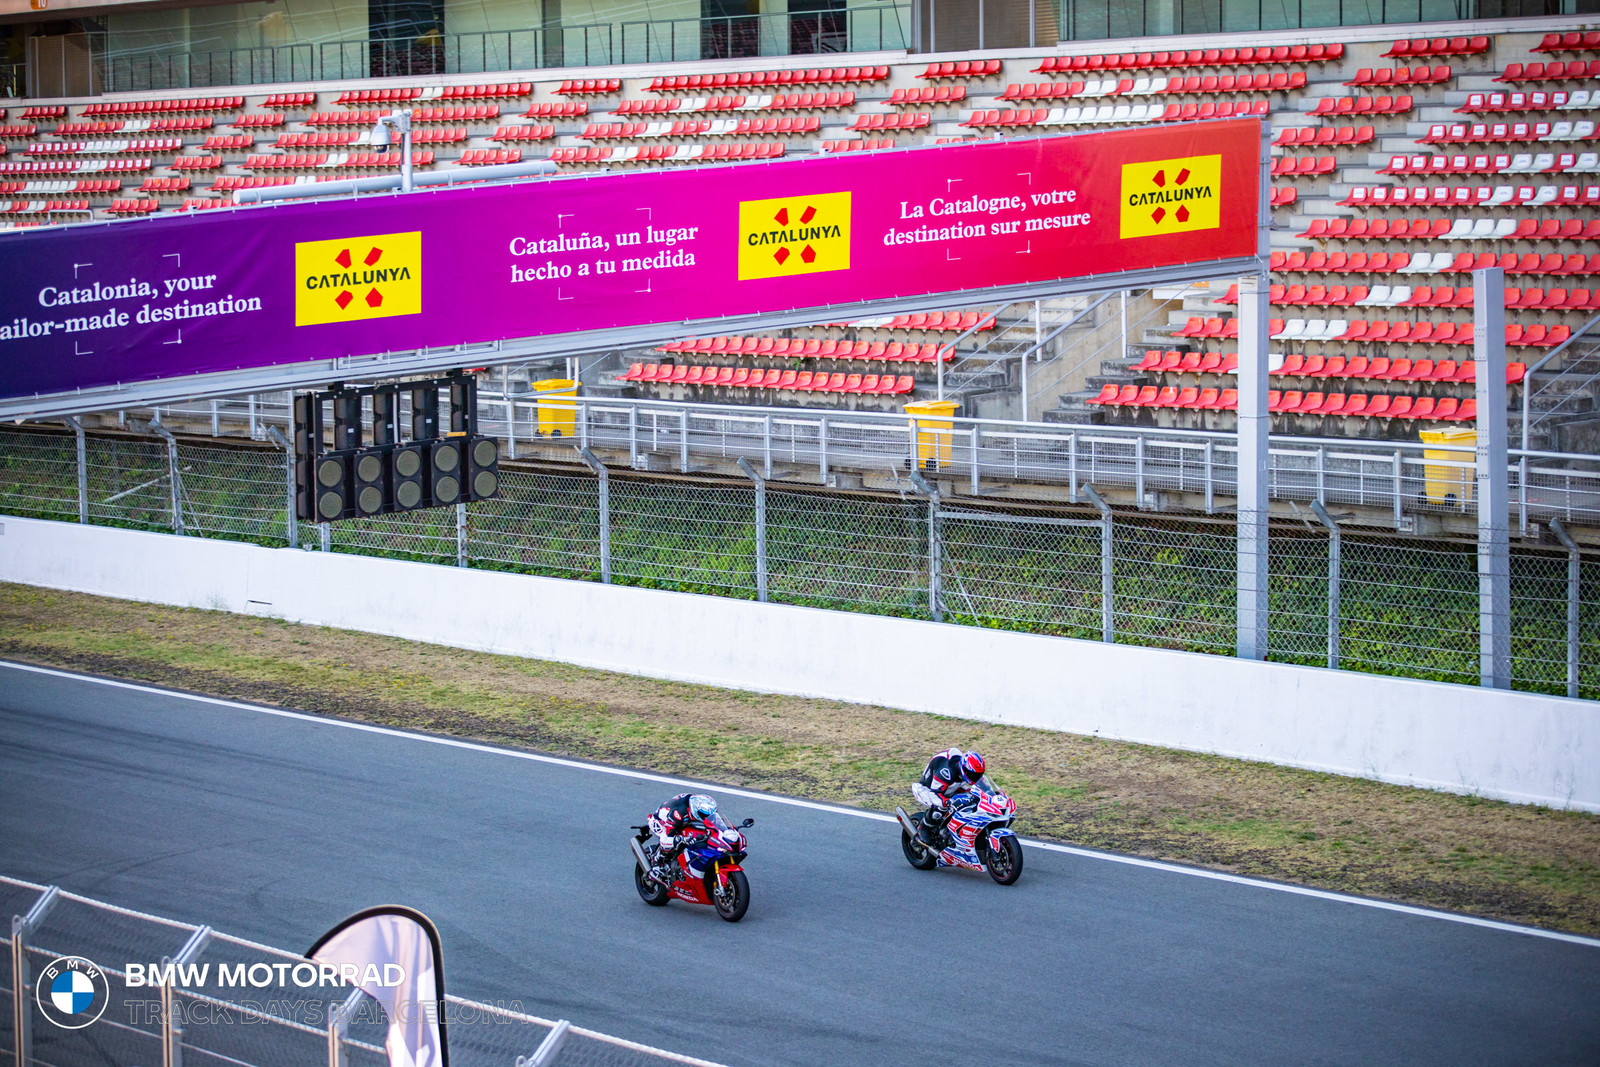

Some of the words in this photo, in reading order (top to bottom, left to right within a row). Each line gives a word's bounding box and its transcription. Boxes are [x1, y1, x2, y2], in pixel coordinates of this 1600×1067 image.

[900, 201, 924, 220] La
[929, 194, 1027, 219] Catalogne,
[1030, 188, 1077, 205] votre
[1129, 186, 1212, 207] CATALUNYA
[509, 233, 610, 256] Cataluña,
[615, 231, 641, 247] un
[646, 225, 698, 247] lugar
[748, 225, 841, 246] CATALUNYA
[883, 222, 986, 246] destination
[991, 219, 1022, 236] sur
[1024, 210, 1091, 232] mesure
[306, 267, 411, 290] CATALUNYA
[510, 263, 572, 282] hecho
[577, 263, 590, 277] a
[595, 259, 616, 275] tu
[621, 249, 696, 271] medida
[38, 278, 159, 308] Catalonia,
[164, 271, 217, 297] your
[0, 305, 130, 340] ailor-made
[136, 294, 262, 325] destination
